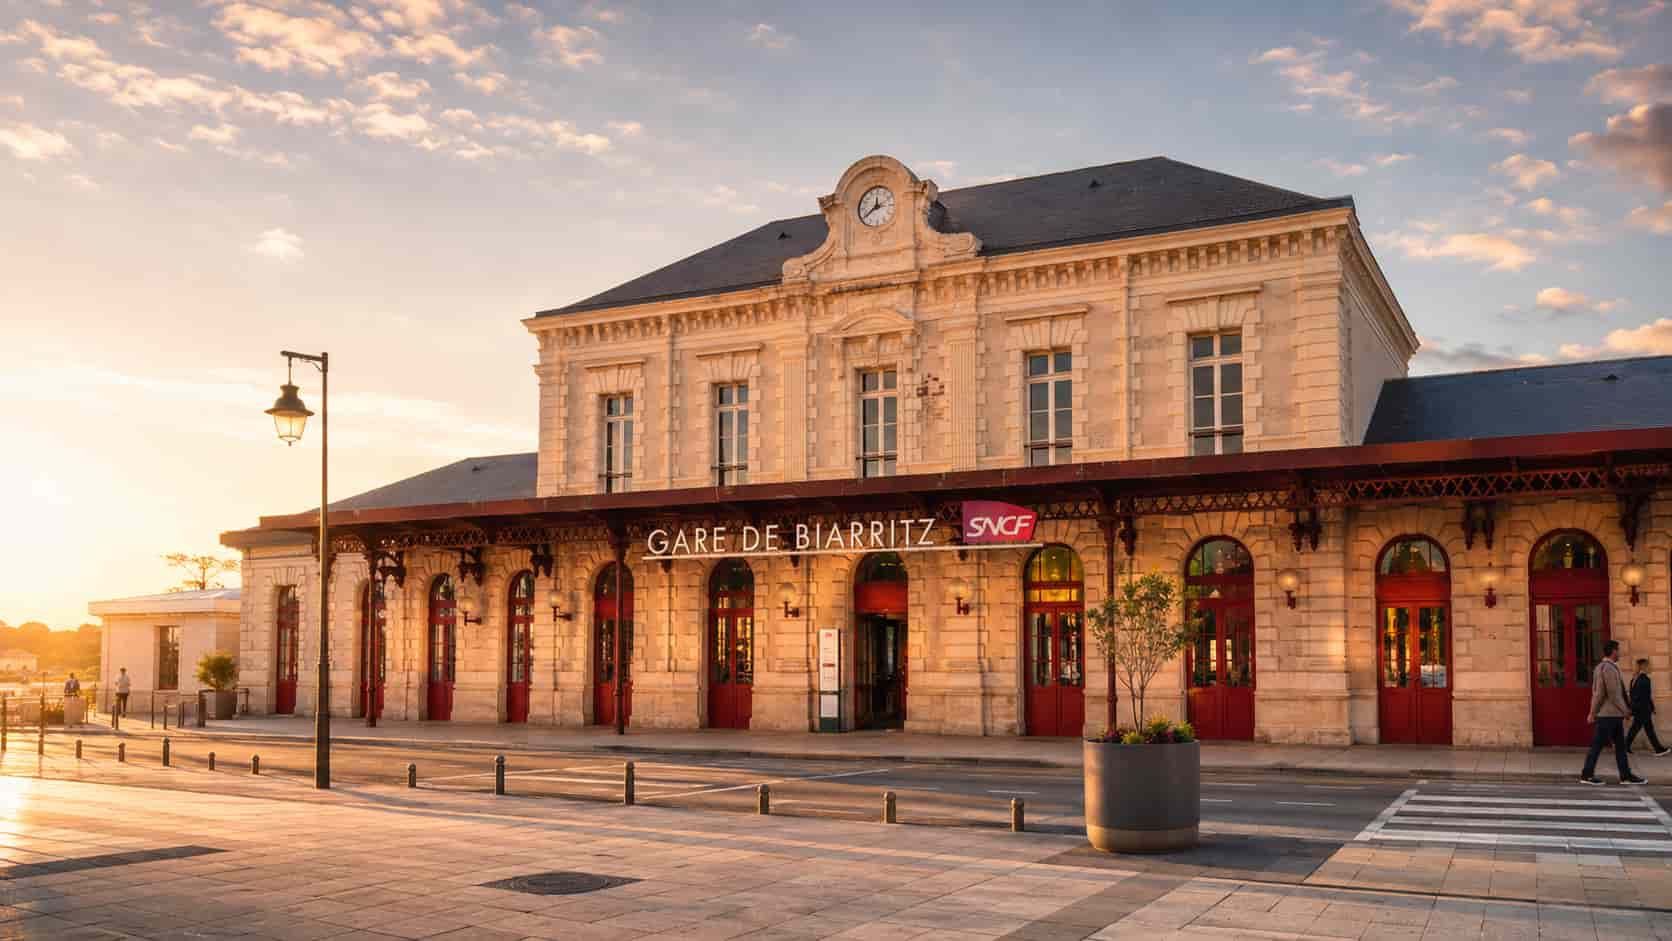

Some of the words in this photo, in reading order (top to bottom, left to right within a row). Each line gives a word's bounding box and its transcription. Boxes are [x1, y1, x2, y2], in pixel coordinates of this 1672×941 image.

[647, 527, 726, 555] GARE
[743, 524, 779, 551] DE
[796, 518, 936, 550] BIARRITZ
[966, 515, 1033, 537] SNCF
